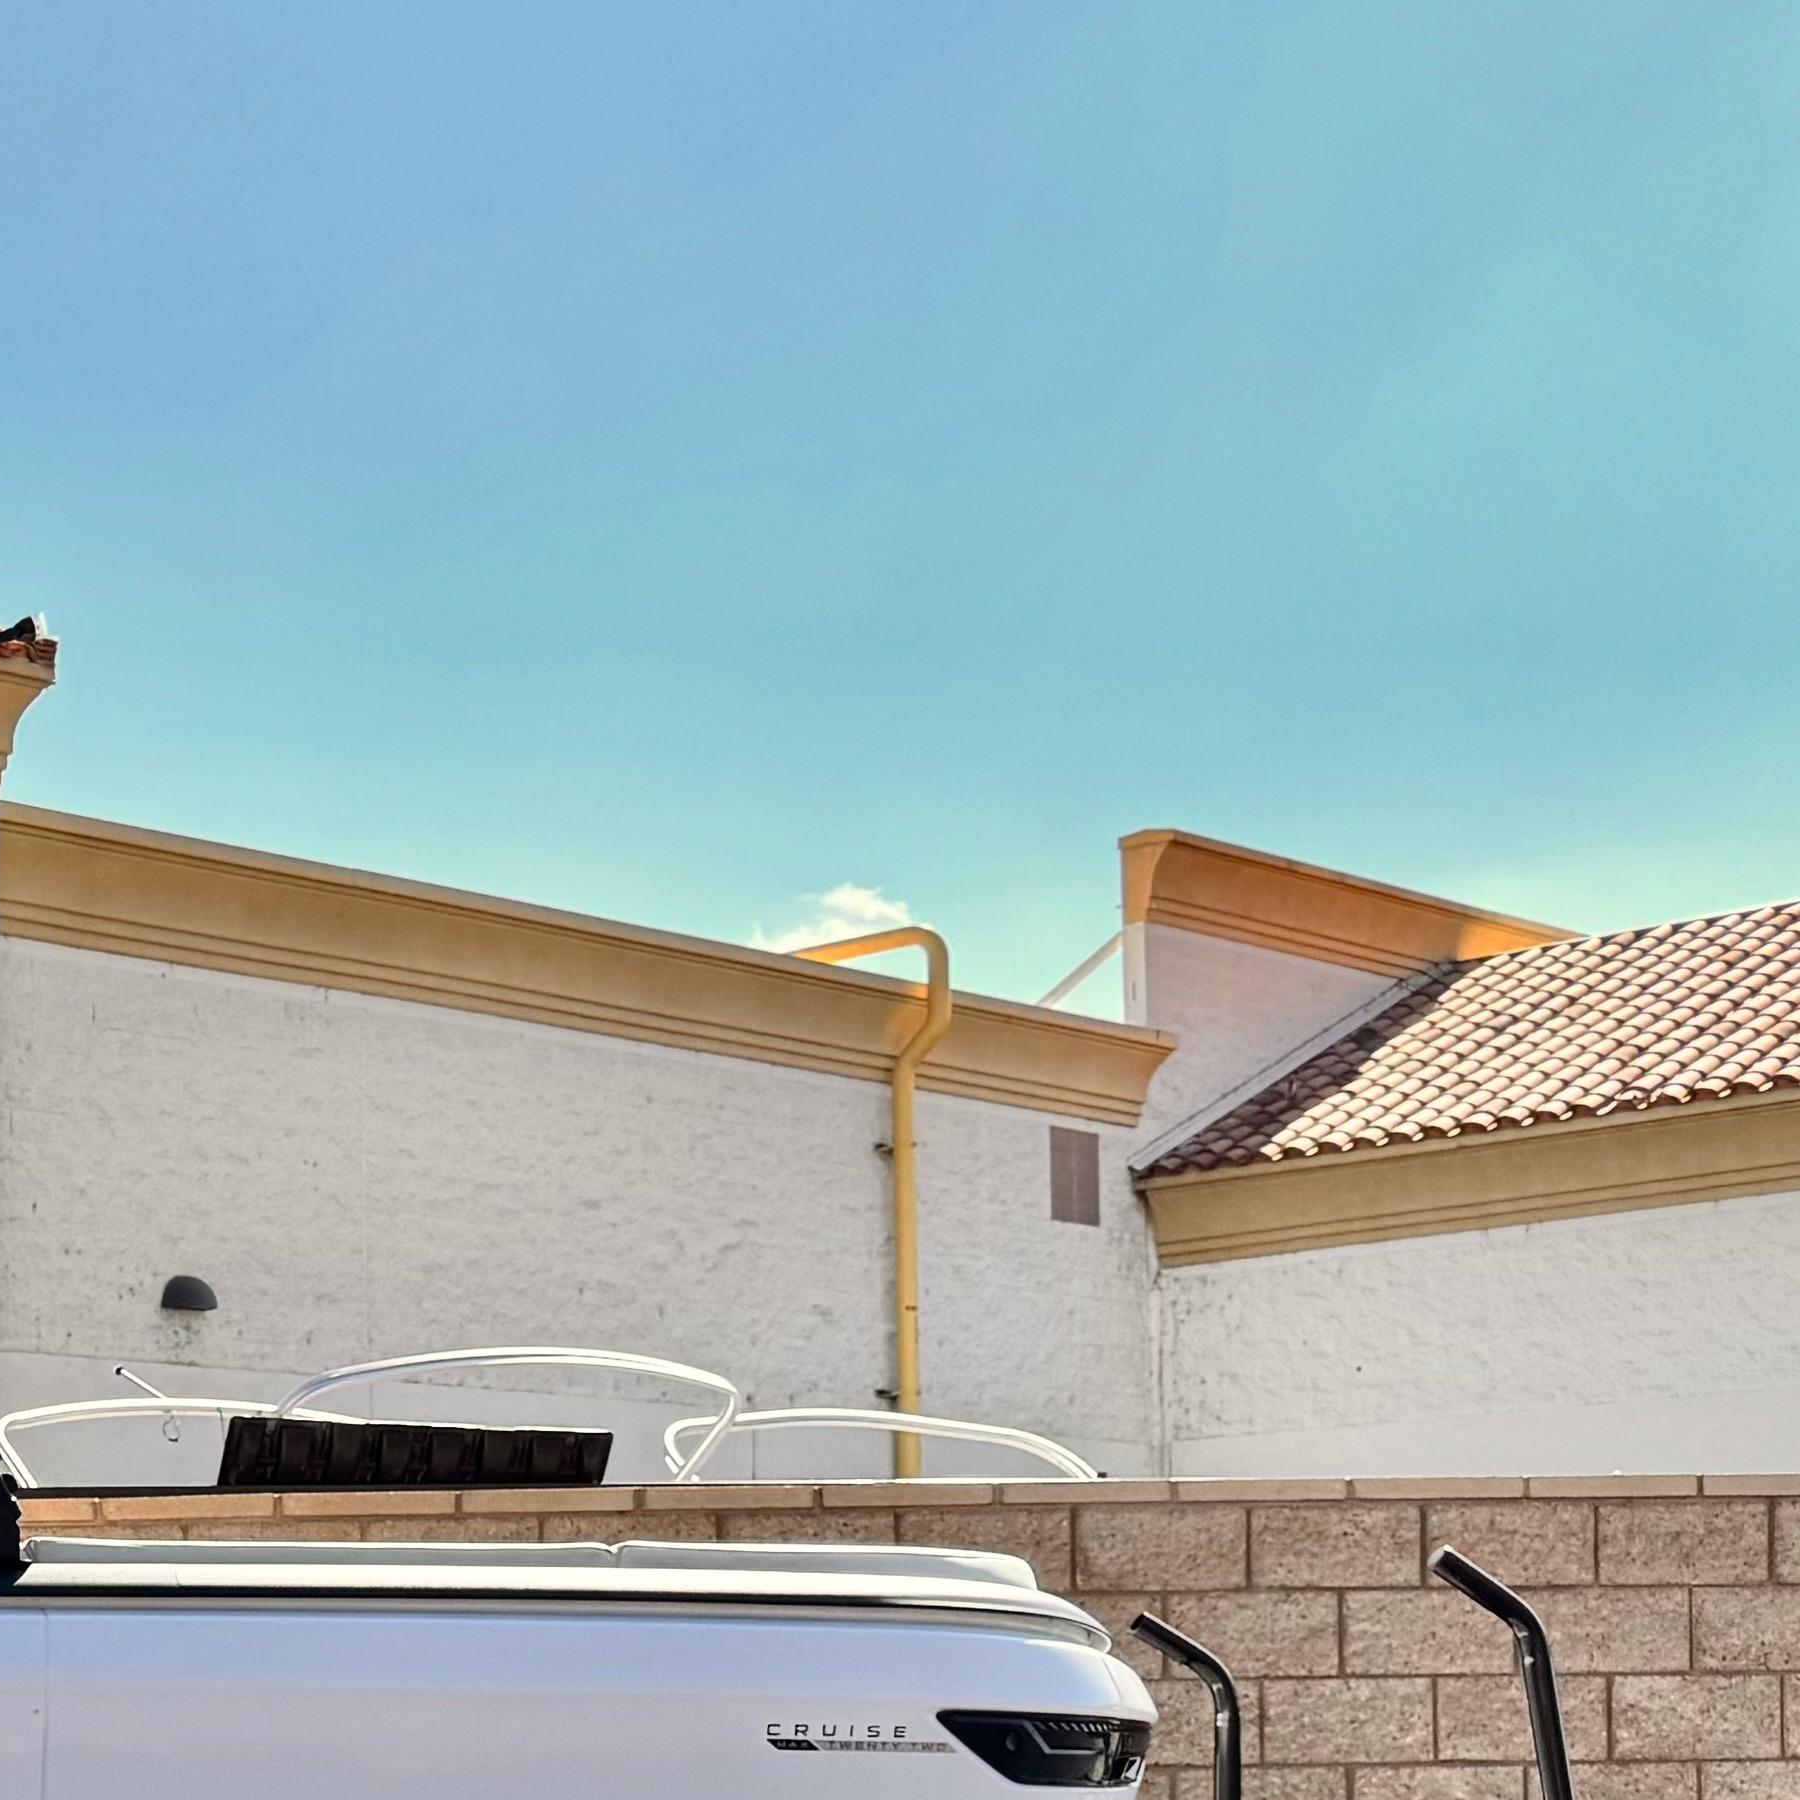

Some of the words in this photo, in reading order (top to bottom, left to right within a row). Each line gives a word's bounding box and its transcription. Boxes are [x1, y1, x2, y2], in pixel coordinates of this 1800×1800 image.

[766, 1723, 907, 1738] CRUISE
[828, 1740, 902, 1750] TWENTY
[911, 1742, 947, 1751] TWO
